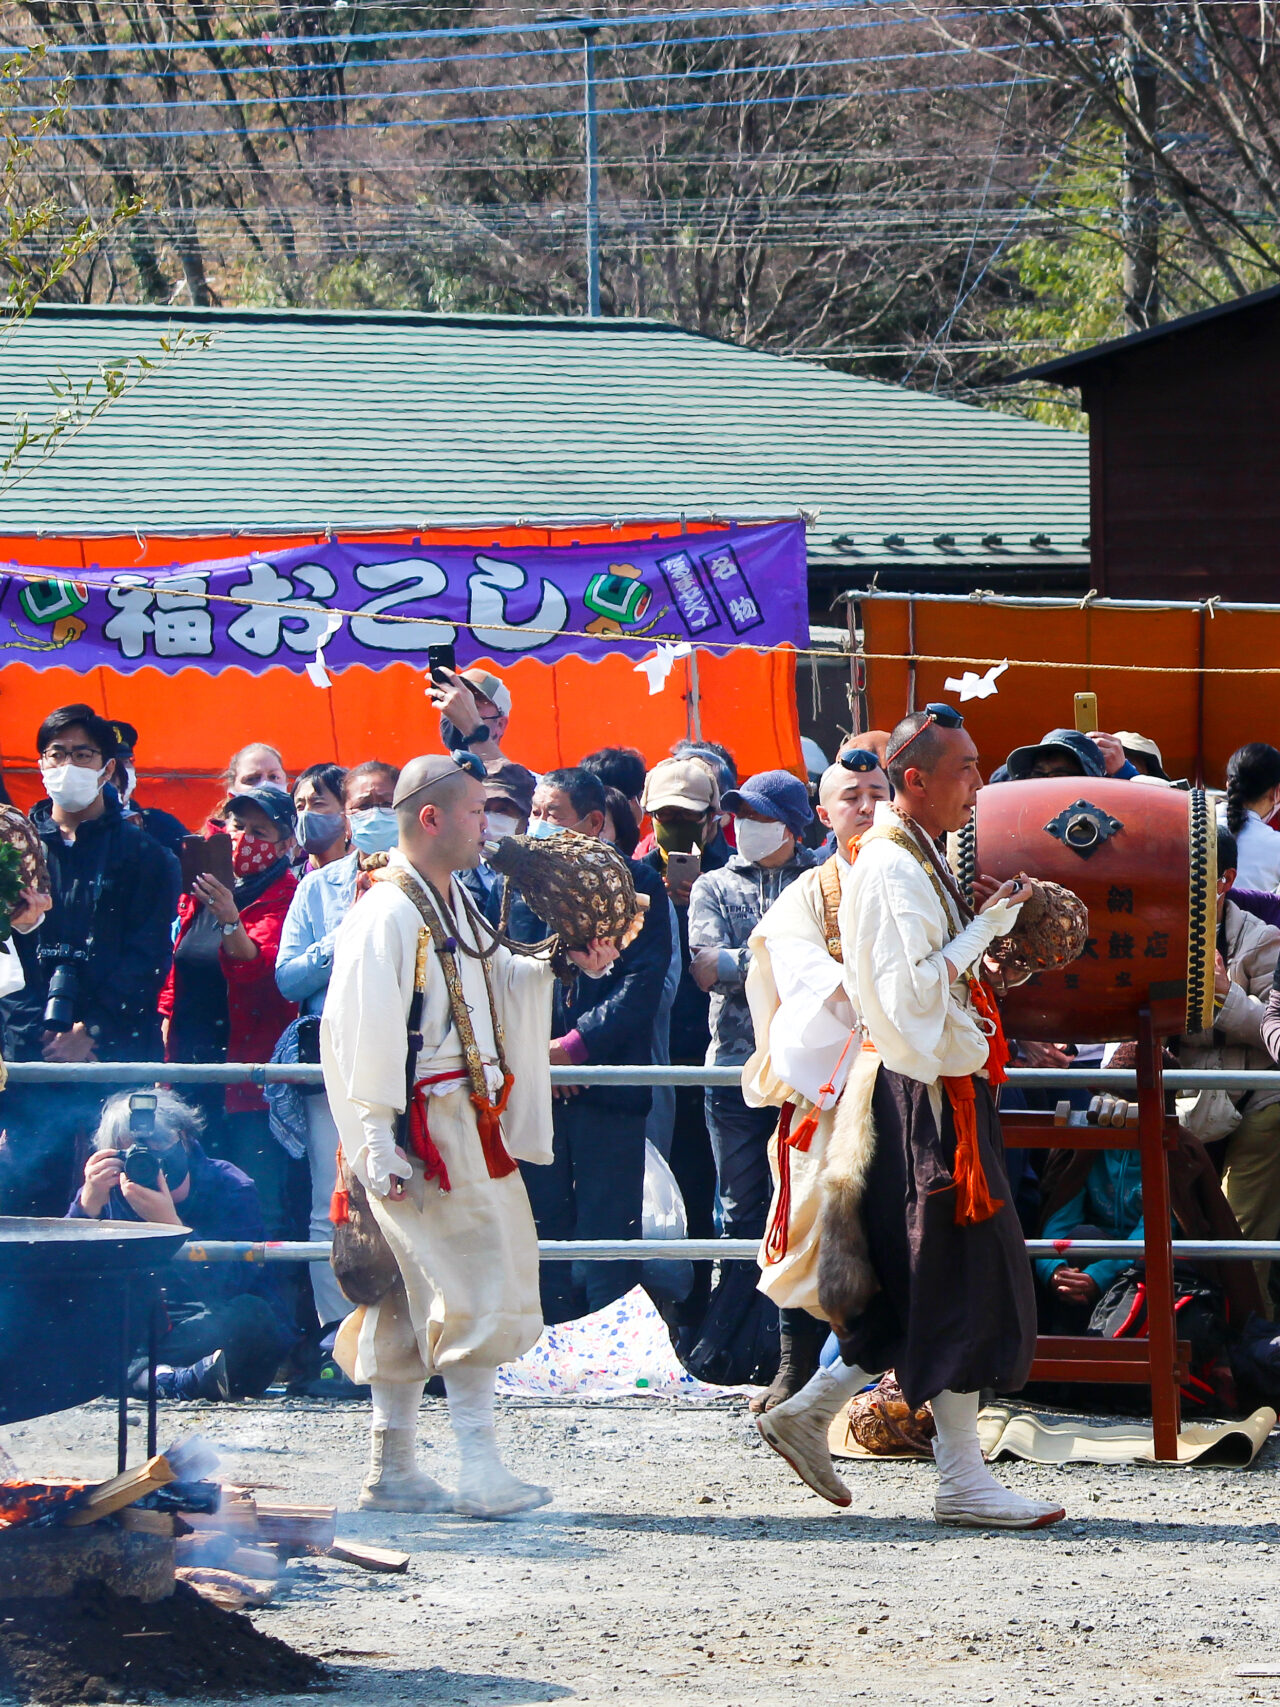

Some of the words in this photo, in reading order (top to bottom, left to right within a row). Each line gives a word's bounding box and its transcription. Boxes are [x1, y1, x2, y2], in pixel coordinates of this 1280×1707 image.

[104, 554, 570, 659] 福おこし
[711, 556, 758, 622] 名物
